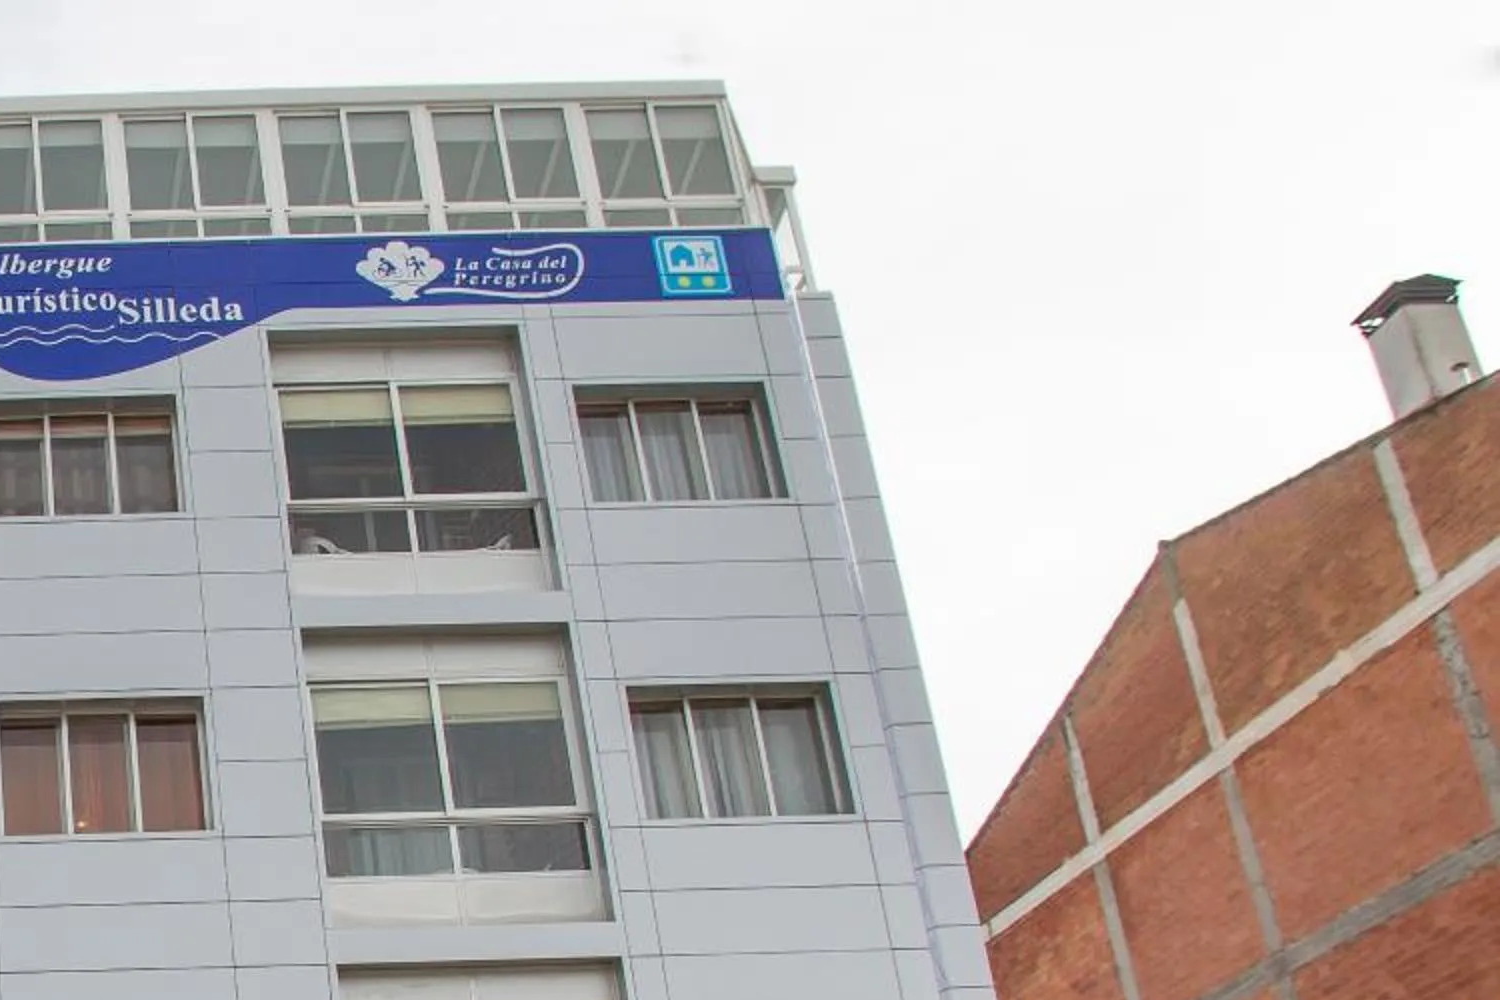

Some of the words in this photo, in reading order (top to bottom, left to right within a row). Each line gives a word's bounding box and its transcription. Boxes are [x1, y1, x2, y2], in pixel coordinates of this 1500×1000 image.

[455, 257, 479, 271] La
[486, 257, 533, 270] Casa
[537, 255, 567, 269] del
[454, 271, 566, 289] Peregrino
[118, 296, 244, 325] Silleda
